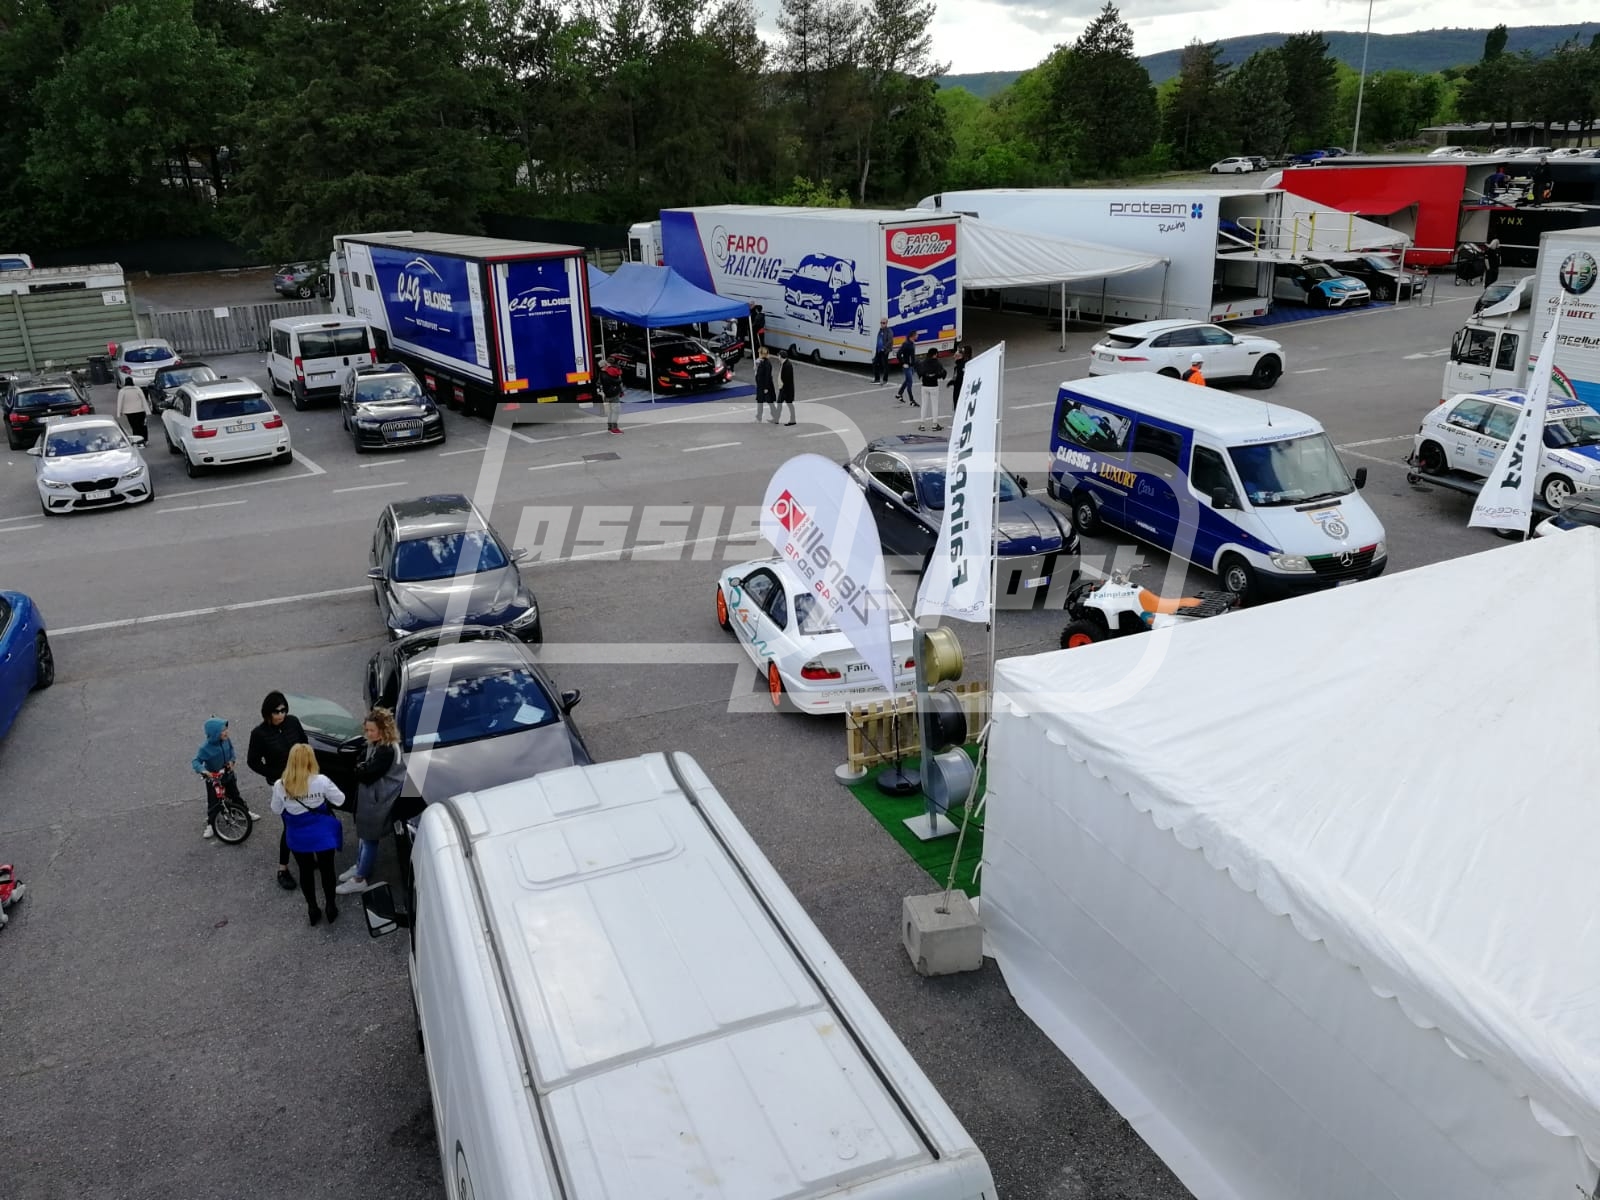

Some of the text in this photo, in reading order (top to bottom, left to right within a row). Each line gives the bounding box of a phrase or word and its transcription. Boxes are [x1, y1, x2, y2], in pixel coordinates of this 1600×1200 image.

[1109, 202, 1187, 216] proteam
[1158, 221, 1186, 233] Racing
[727, 234, 768, 255] FARO
[906, 233, 939, 245] FARO
[903, 240, 949, 256] RACING
[724, 254, 782, 281] RACING
[397, 272, 454, 313] CLG BLOISE
[508, 297, 537, 312] CLG
[1056, 445, 1091, 470] CLASSIC
[1091, 462, 1098, 473] &
[1099, 461, 1138, 489] LUXURY
